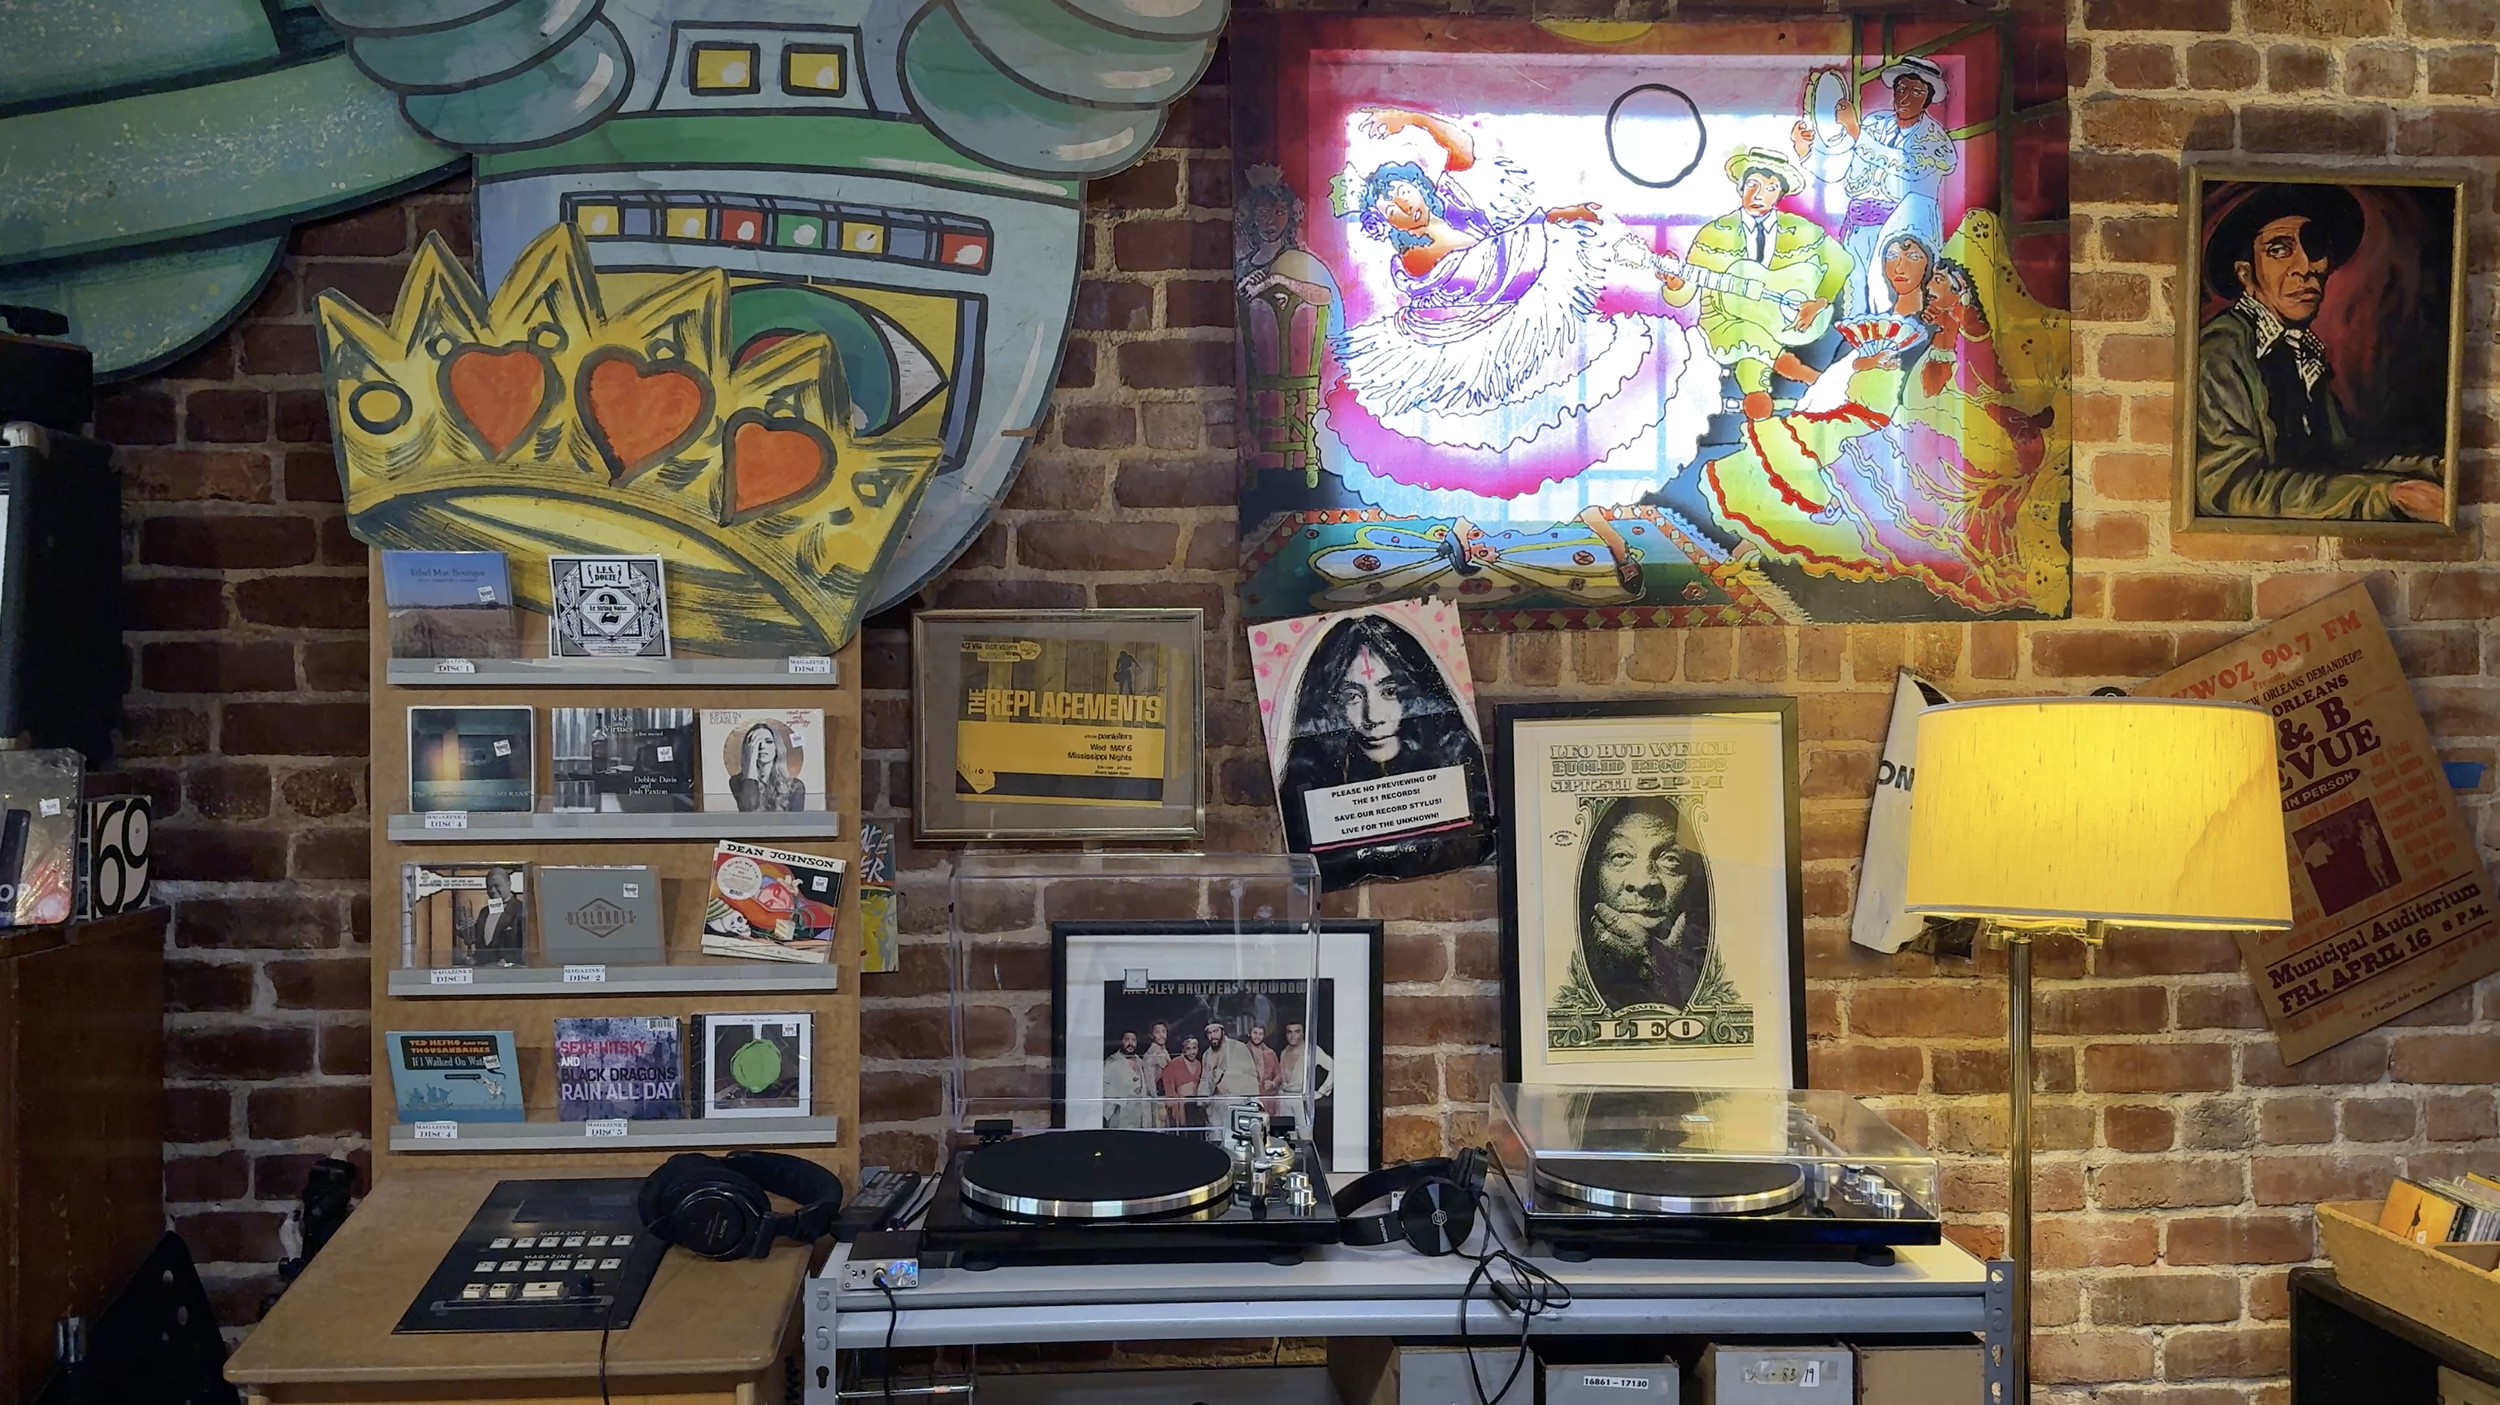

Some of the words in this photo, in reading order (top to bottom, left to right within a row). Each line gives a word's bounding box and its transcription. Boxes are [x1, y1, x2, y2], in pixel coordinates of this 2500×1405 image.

[2261, 632, 2312, 669] 90.7
[2321, 609, 2362, 642] FM
[2252, 671, 2286, 692] Presents
[2263, 676, 2305, 702] ORLEANS
[2306, 649, 2363, 683] DEMANDED!!!
[968, 688, 985, 715] THE
[985, 689, 1161, 723] REPLACEMENTS
[2271, 674, 2349, 717] ORLEANS
[2278, 718, 2314, 751] &
[2315, 696, 2351, 733] B
[1067, 752, 1107, 761] Mississippi
[1109, 754, 1133, 762] Nights
[1090, 743, 1107, 751] Wed
[1550, 744, 1594, 759] LEO
[1597, 743, 1645, 758] BUD
[1649, 741, 1736, 756] WELCH
[1552, 759, 1626, 776] EUCLID
[1631, 758, 1727, 774] RECORDS
[628, 788, 643, 796] Josh
[1331, 787, 1361, 798] PLEASE
[1376, 776, 1425, 790] PREVIEWING
[1381, 788, 1421, 801] RECORDS!
[1551, 779, 1589, 792] SEPT
[2285, 796, 2300, 810] IN
[2302, 771, 2354, 802] PERSON
[1334, 813, 1355, 822] SAVE
[1357, 810, 1374, 818] OUR
[1376, 804, 1408, 815] RECORD
[1409, 798, 1442, 809] STYLUS!
[1341, 826, 1359, 834] LIVE
[1361, 823, 1377, 831] FOR
[1379, 820, 1394, 829] THE
[1396, 812, 1439, 825] UNKNOWN!
[727, 843, 764, 857] DEAN
[769, 851, 834, 868] JOHNSON
[2267, 930, 2369, 989] Municipal
[2372, 882, 2481, 943] Auditorium
[2278, 978, 2328, 1013] FRI.
[2332, 942, 2405, 990] APRIL
[2405, 928, 2432, 953] 16
[2442, 921, 2453, 932] 8
[2456, 904, 2489, 927] P.M.
[1143, 983, 1174, 995] SLEY
[1177, 982, 1239, 995] BROTHERS
[1245, 981, 1307, 994] SHOWDOW
[1592, 1018, 1705, 1041] LEO
[599, 1041, 646, 1055] HITSKY
[411, 1056, 419, 1067] If
[425, 1057, 453, 1067] Walked
[455, 1057, 466, 1066] On
[560, 1057, 580, 1066] AND
[561, 1068, 606, 1081] BLACK
[610, 1067, 677, 1081] DRAGONS
[562, 1083, 601, 1100] RAIN
[606, 1082, 640, 1100] ALL
[643, 1082, 676, 1100] DAY
[1584, 1377, 1611, 1387] 16861
[1621, 1378, 1648, 1388] 17130
